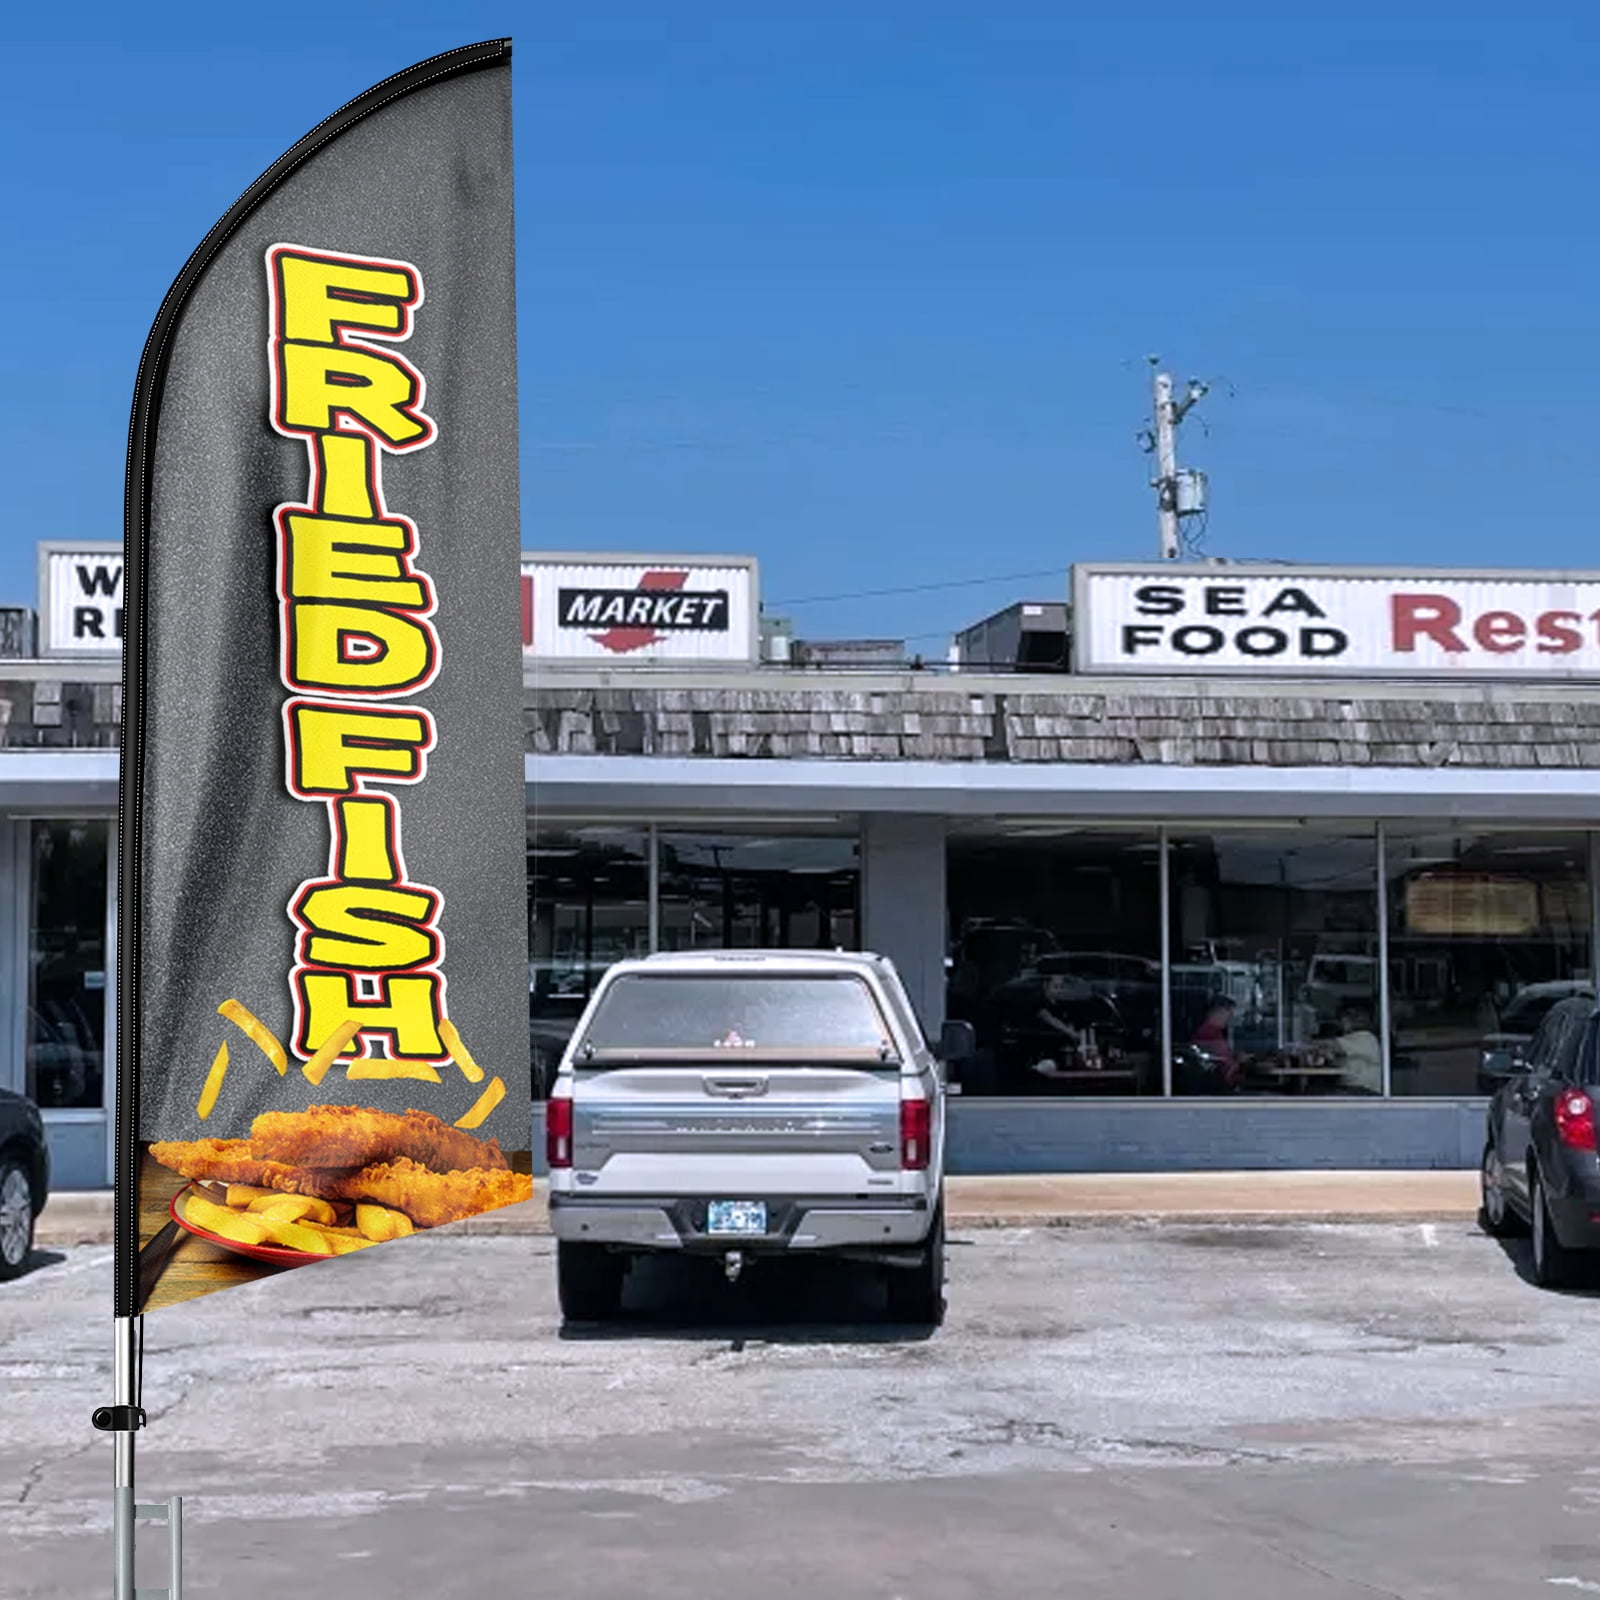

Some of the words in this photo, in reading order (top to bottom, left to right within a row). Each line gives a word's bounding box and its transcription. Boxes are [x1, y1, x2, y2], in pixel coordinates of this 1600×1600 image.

[269, 246, 440, 695] FRIED
[566, 595, 724, 624] MARKET
[1134, 585, 1327, 619] SEA
[1121, 624, 1348, 657] FOOD
[286, 700, 452, 1065] FISH
